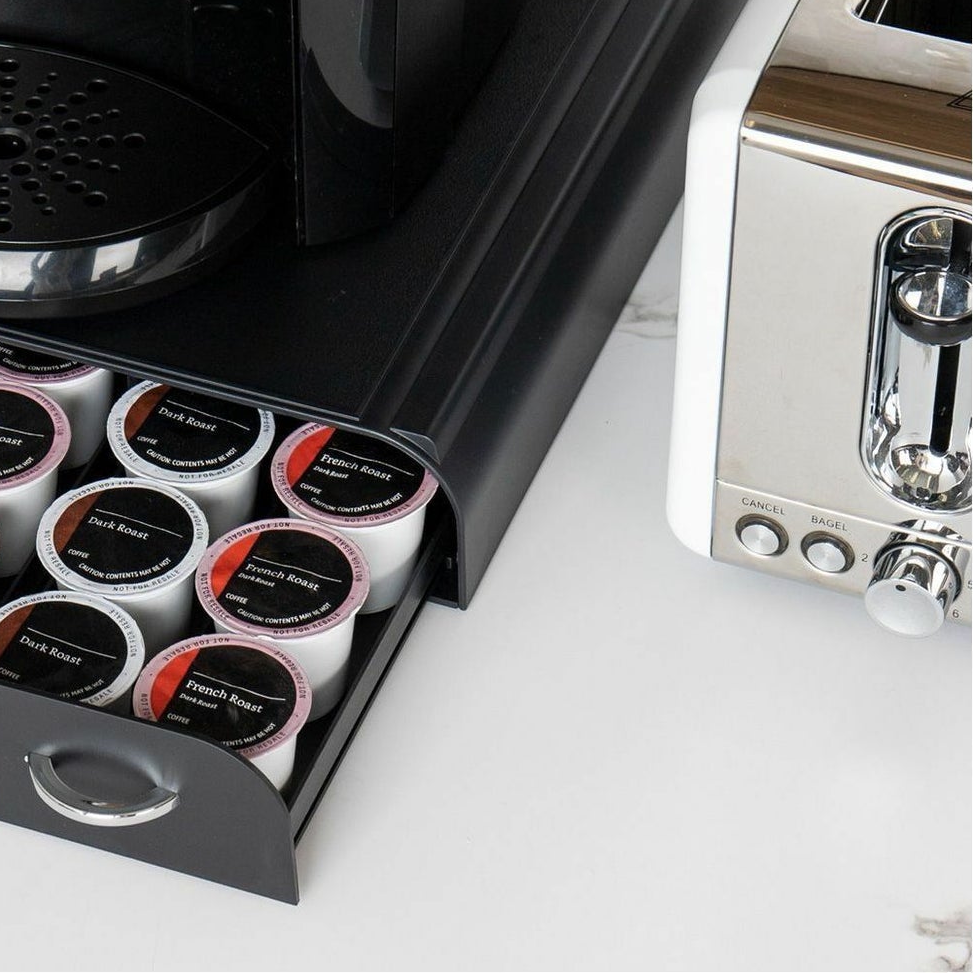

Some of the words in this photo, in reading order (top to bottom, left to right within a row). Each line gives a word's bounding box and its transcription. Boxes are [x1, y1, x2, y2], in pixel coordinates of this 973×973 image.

[158, 407, 185, 422] Dark
[186, 416, 218, 432] Roast
[137, 436, 159, 445] COFFEE
[172, 459, 205, 467] CONTENTS
[218, 453, 227, 461] BE
[226, 447, 237, 457] HOT
[3, 467, 15, 475] MAY
[22, 456, 34, 467] HOT
[313, 466, 331, 476] Dark
[330, 470, 349, 479] Roast
[320, 454, 359, 470] French
[360, 467, 392, 481] Roast
[299, 483, 322, 494] COFFEE
[383, 498, 391, 506] BE
[390, 492, 403, 502] HOT
[742, 497, 785, 516] CANCEL
[88, 516, 116, 530] Dark
[117, 524, 150, 540] Roast
[811, 515, 847, 531] BAGEL
[67, 548, 90, 558] COFFEE
[861, 553, 868, 562] 2
[106, 571, 139, 579] CONTENTS
[139, 568, 152, 577] MAY
[152, 564, 160, 572] BE
[159, 558, 172, 568] HOT
[238, 572, 256, 582] Dark
[255, 577, 276, 587] Roast
[245, 564, 285, 579] French
[286, 573, 320, 592] Roast
[225, 592, 248, 604] COFFEE
[299, 612, 312, 620] MAY
[312, 608, 320, 616] BE
[319, 602, 332, 612] HOT
[953, 609, 960, 618] 6
[19, 635, 48, 653] Dark
[49, 647, 82, 665] Roast
[71, 688, 84, 696] MAY
[186, 680, 227, 700] French
[228, 693, 263, 713] Roast
[179, 693, 197, 703] Dark
[197, 698, 218, 709] Roast
[167, 713, 191, 724] COFFEE
[244, 736, 258, 744] MAY
[258, 732, 266, 740] BE
[264, 723, 276, 734] HOT
